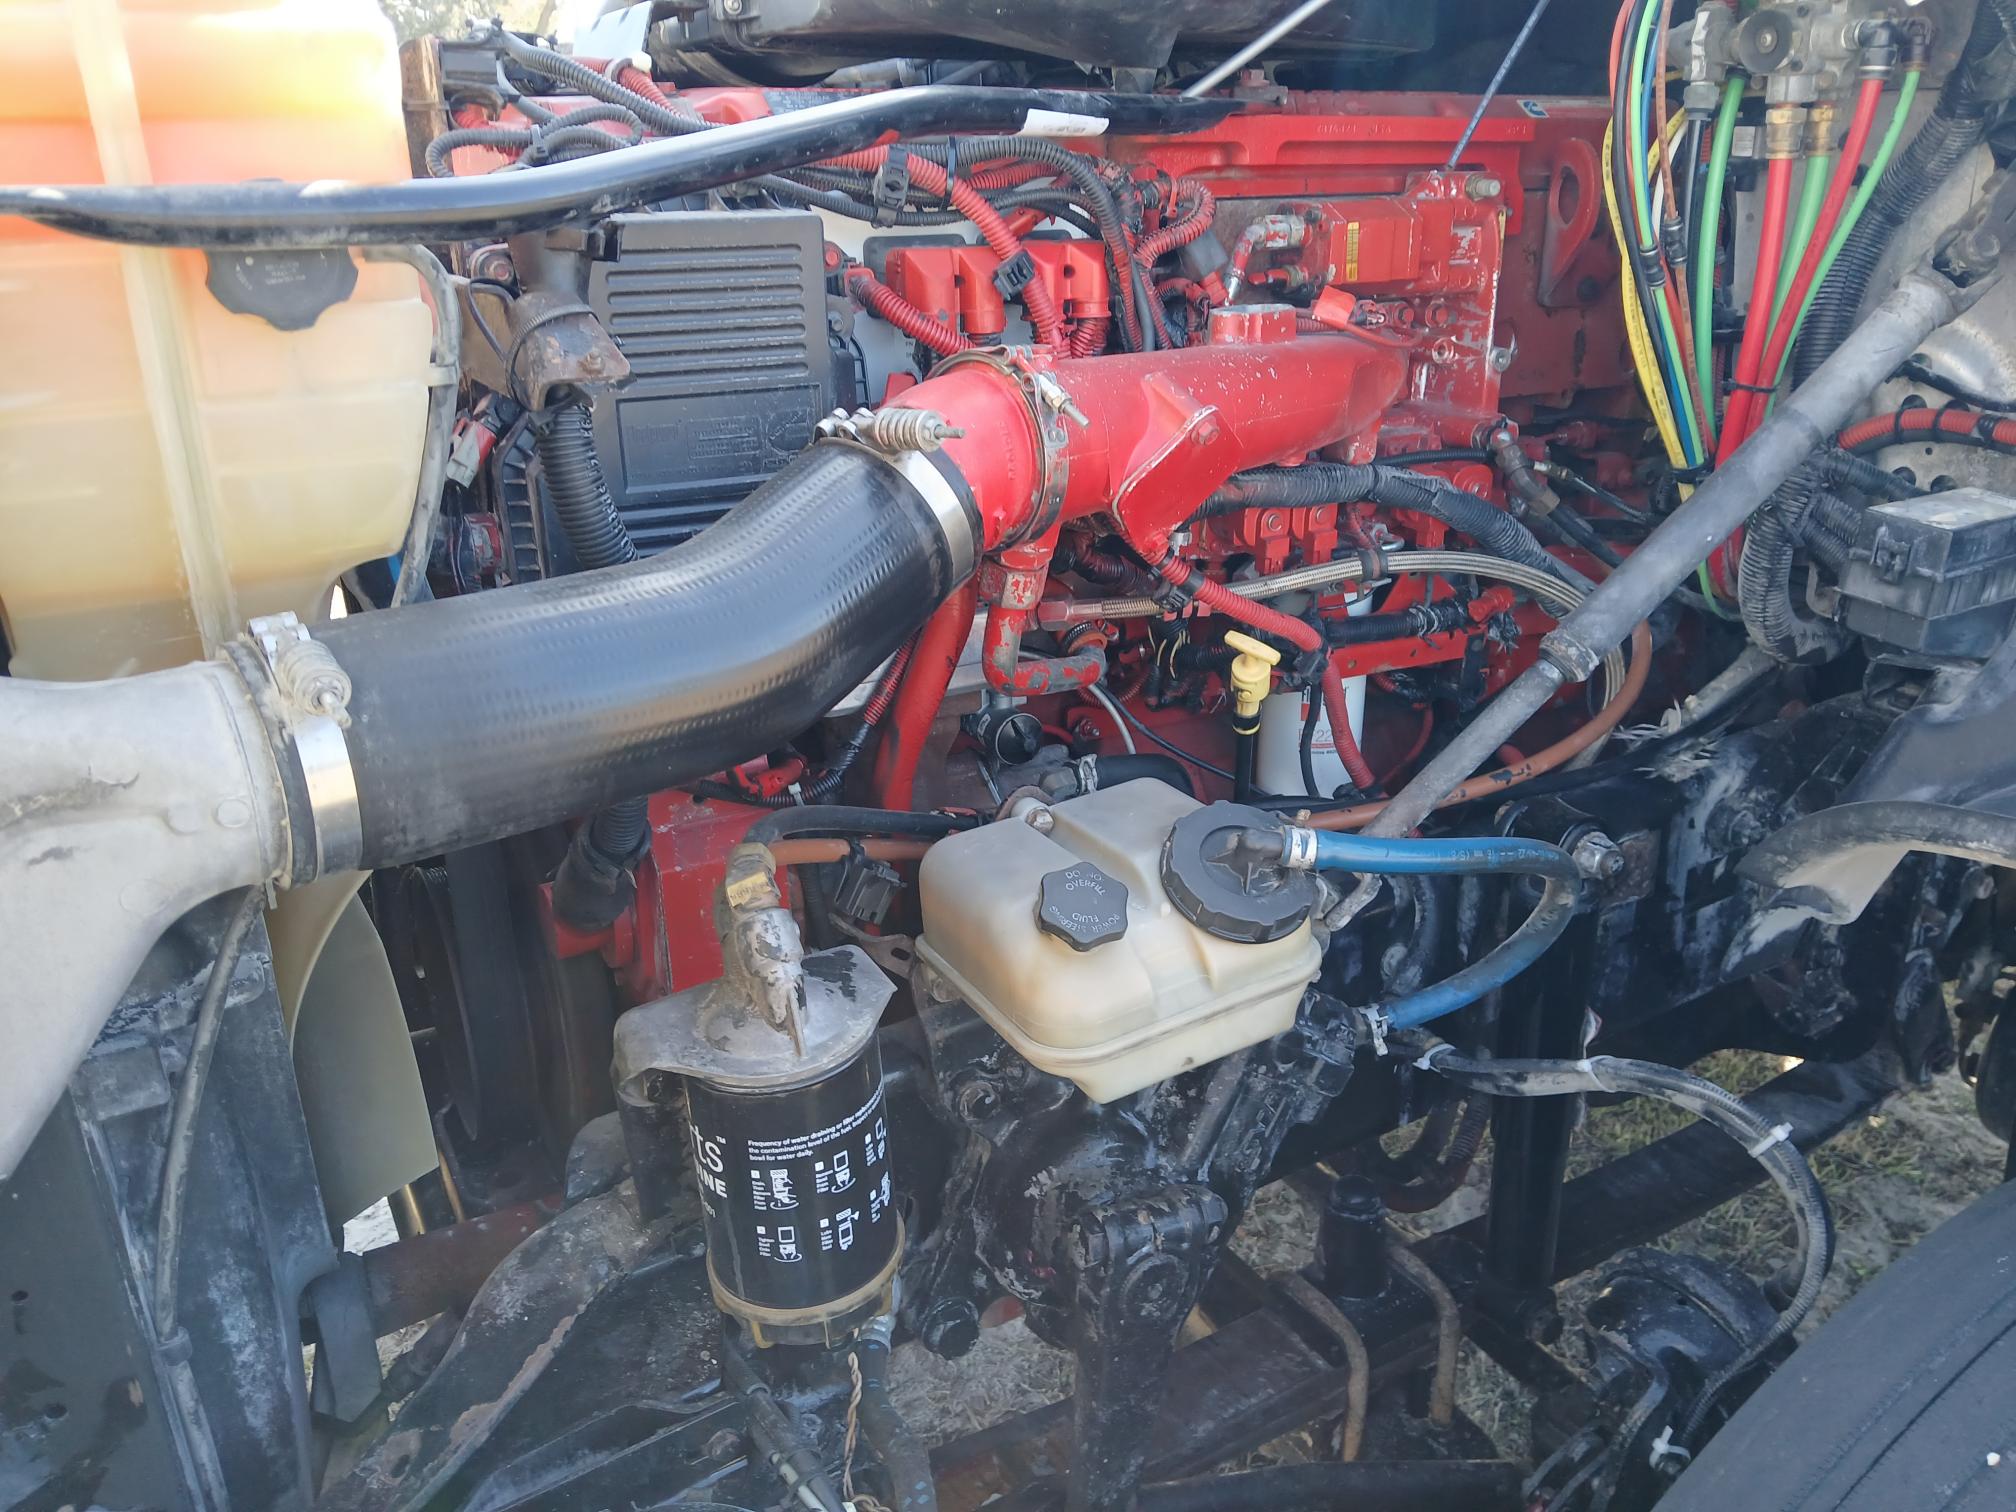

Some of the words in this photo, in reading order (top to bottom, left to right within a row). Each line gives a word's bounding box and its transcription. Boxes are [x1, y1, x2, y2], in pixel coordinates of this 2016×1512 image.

[1065, 870, 1081, 879] DO
[1065, 879, 1106, 896] OVERFILL
[1072, 912, 1100, 923] FLUID
[748, 1140, 781, 1148] Frequency
[791, 1135, 809, 1144] water
[811, 1127, 835, 1139] draining
[760, 1142, 806, 1154] contamination
[808, 1139, 822, 1147] level
[831, 1131, 840, 1140] the
[777, 1153, 795, 1161] water
[797, 1150, 813, 1158] daily.
